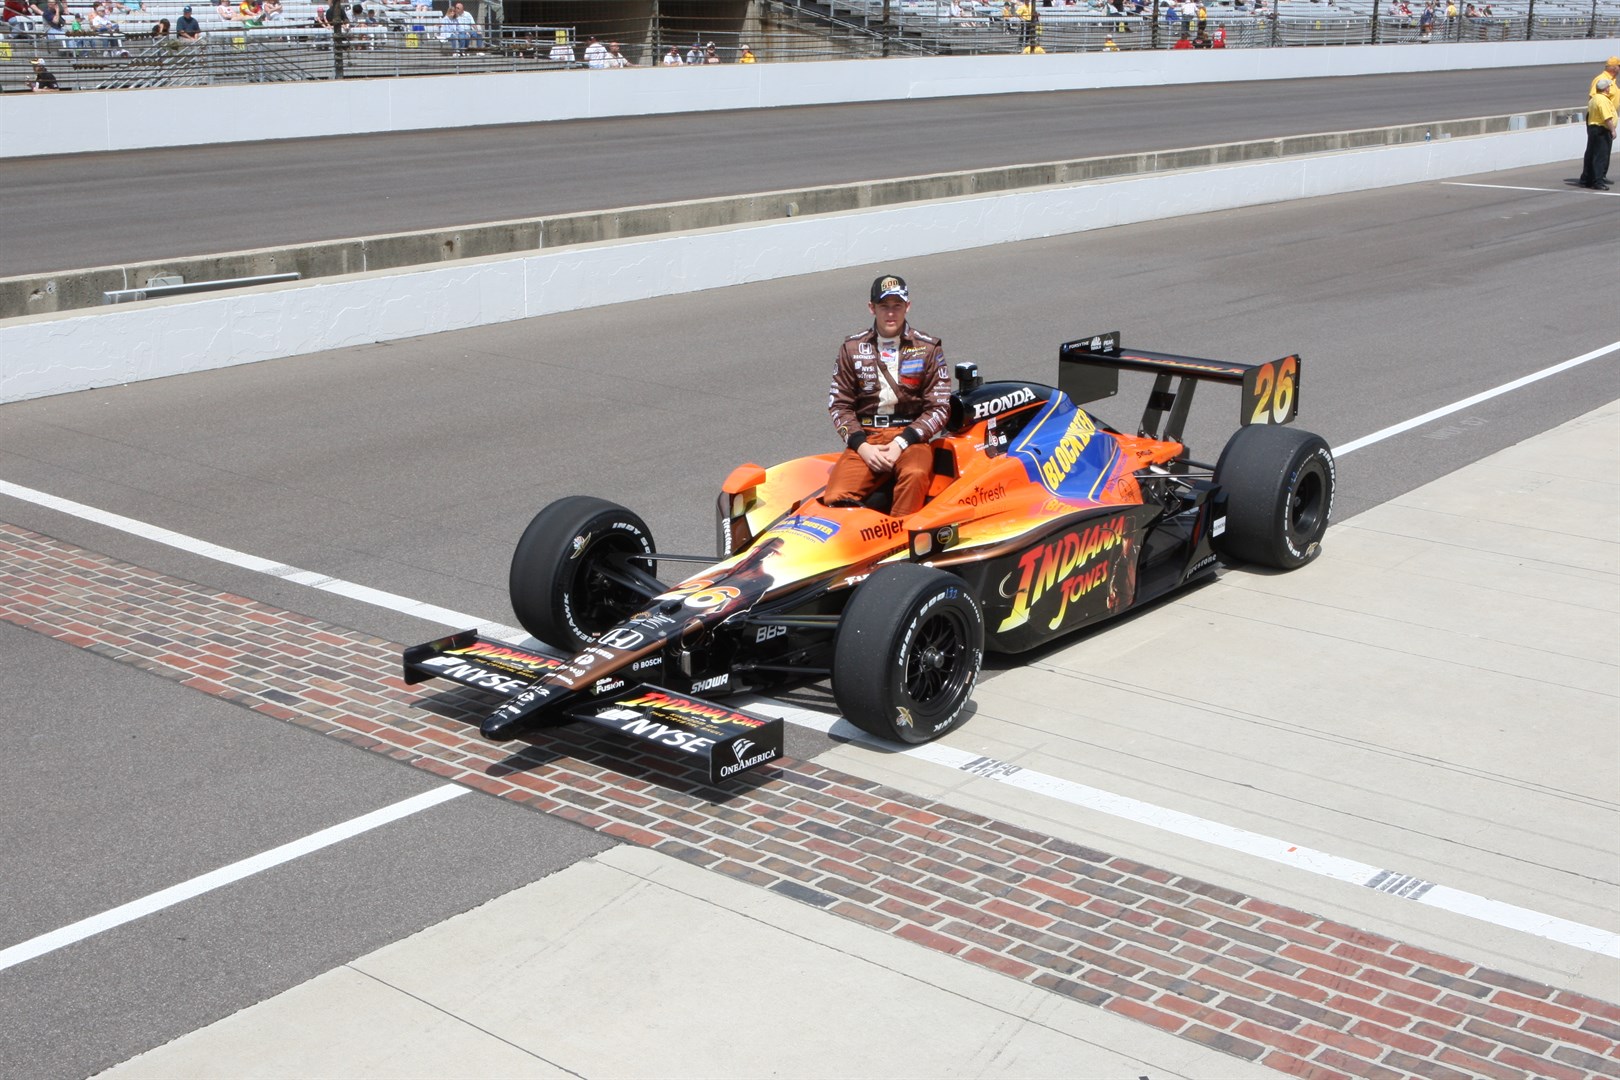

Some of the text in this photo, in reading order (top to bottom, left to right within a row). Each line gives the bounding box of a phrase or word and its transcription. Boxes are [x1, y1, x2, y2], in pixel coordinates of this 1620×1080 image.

[973, 387, 1036, 420] HONDA
[1250, 355, 1297, 425] 26
[612, 522, 641, 535] INDY
[860, 519, 904, 542] meijer
[997, 515, 1125, 634] INDIANA
[653, 578, 741, 610] 26
[1048, 559, 1109, 631] JONES
[755, 624, 788, 644] BBS
[898, 616, 918, 667] INDY
[919, 591, 947, 617] 500
[442, 641, 546, 664] INDIANA
[640, 657, 663, 670] BOSCH
[442, 664, 529, 693] NYSE
[596, 680, 625, 695] Fusion
[690, 673, 730, 695] SHOWA
[614, 691, 730, 722] INDIANA
[620, 719, 717, 753] NYSE
